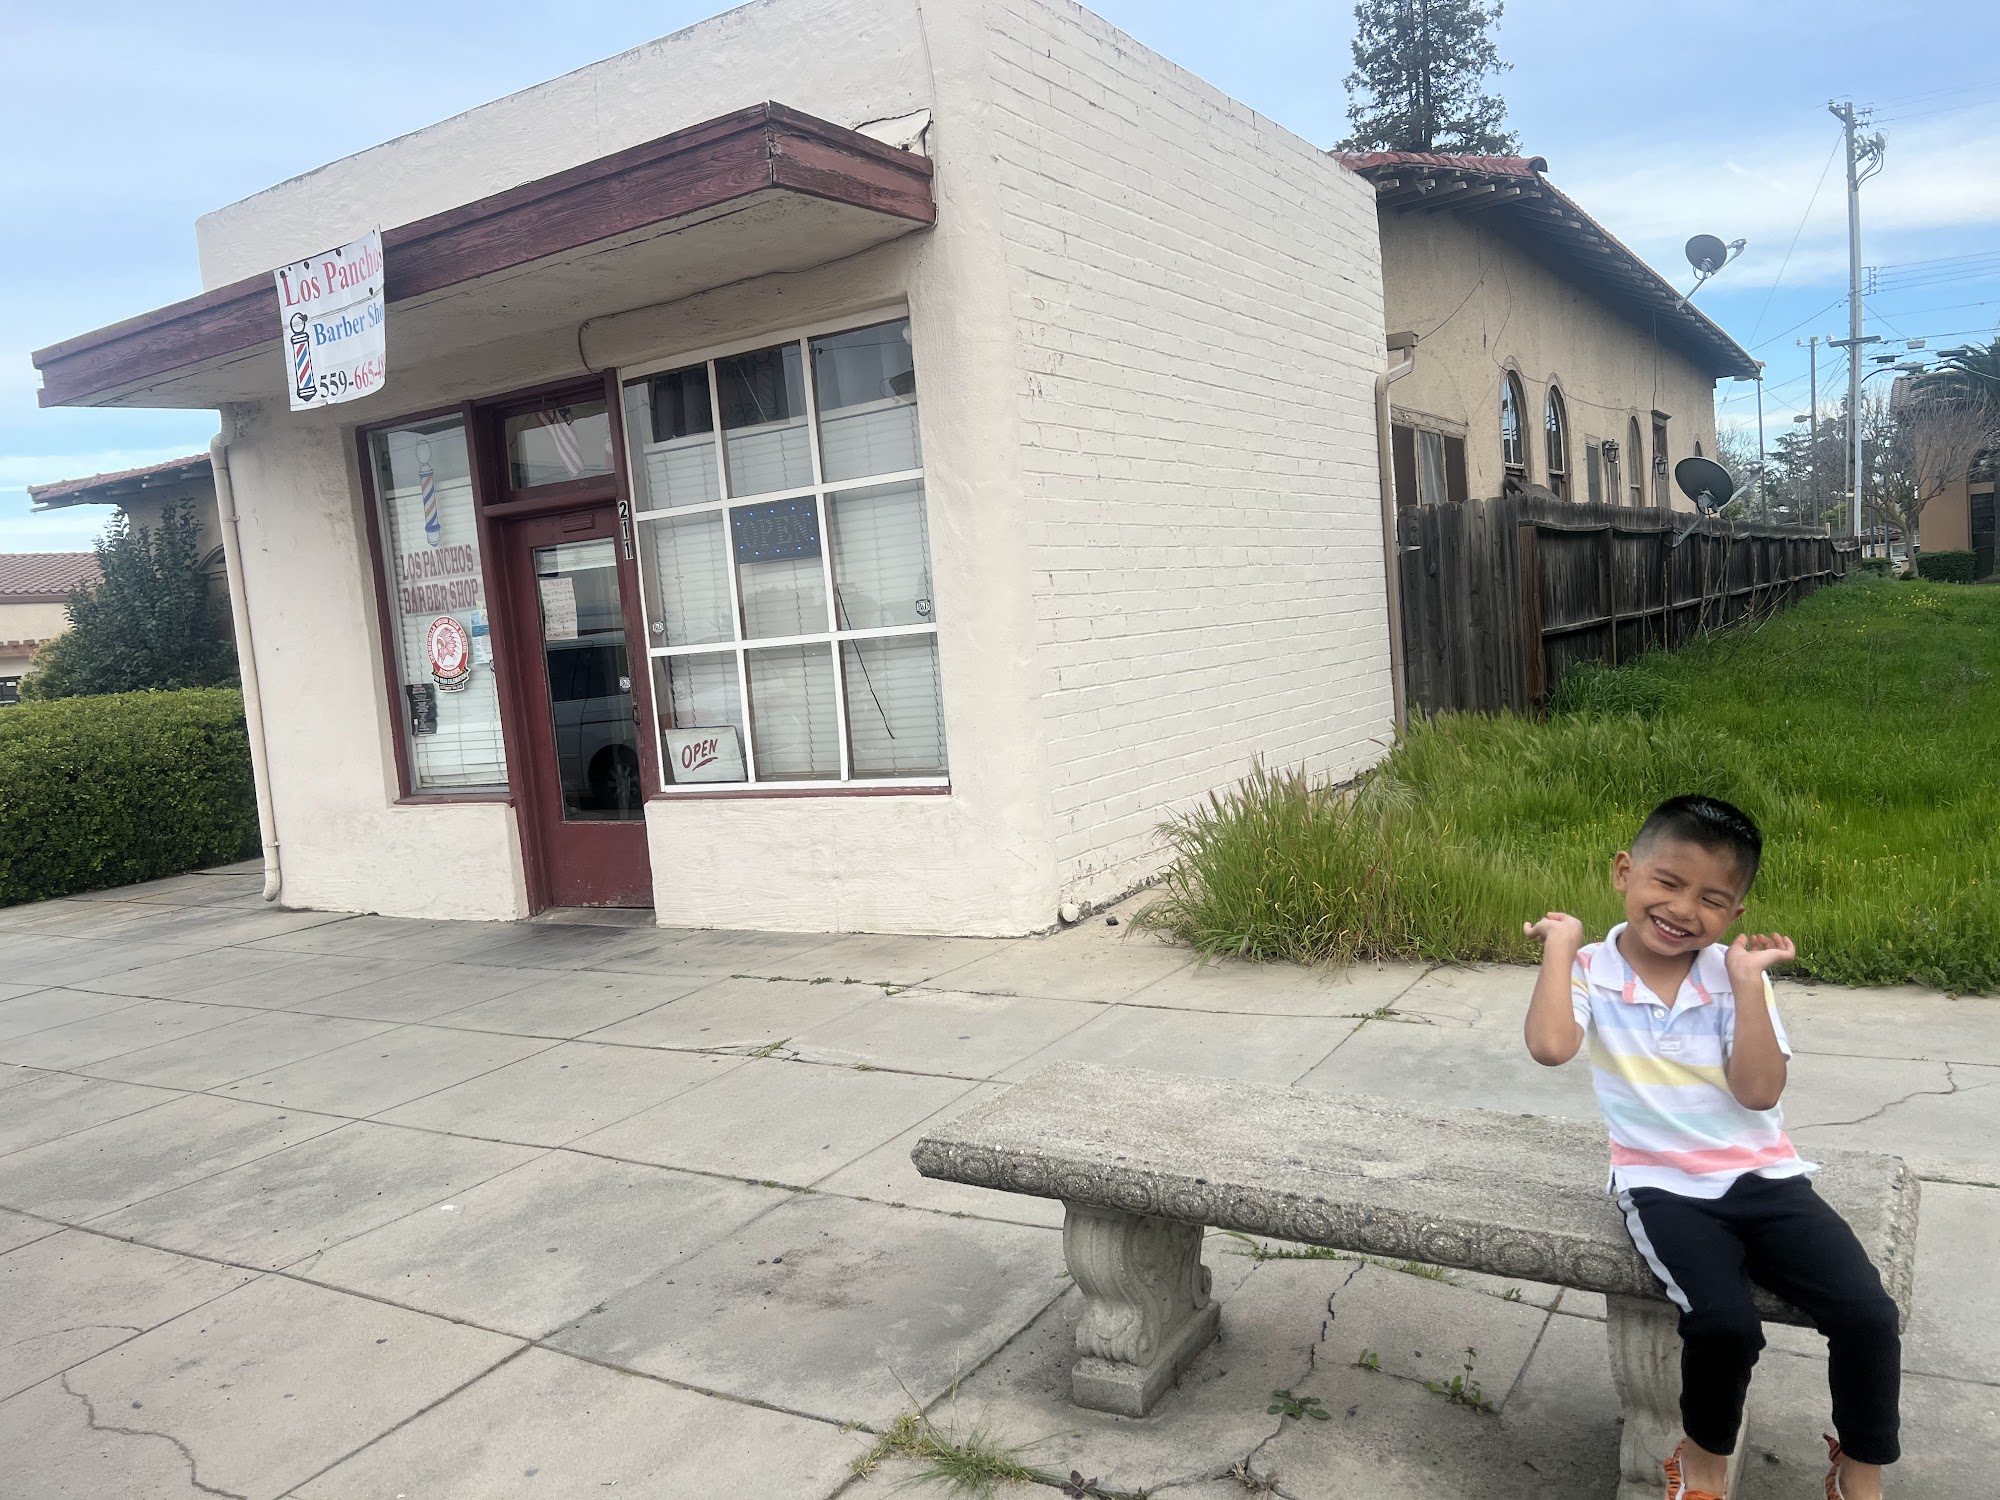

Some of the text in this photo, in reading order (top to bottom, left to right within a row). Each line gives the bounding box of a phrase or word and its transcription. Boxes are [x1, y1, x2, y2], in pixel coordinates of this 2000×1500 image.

[281, 245, 383, 307] Los Panchos
[313, 300, 385, 346] Barber Sho
[619, 502, 631, 559] 211
[742, 513, 809, 547] OPEN
[400, 544, 473, 580] LOS PANCHOS
[403, 579, 478, 614] BARBER SHOP
[682, 738, 718, 769] OPEN
